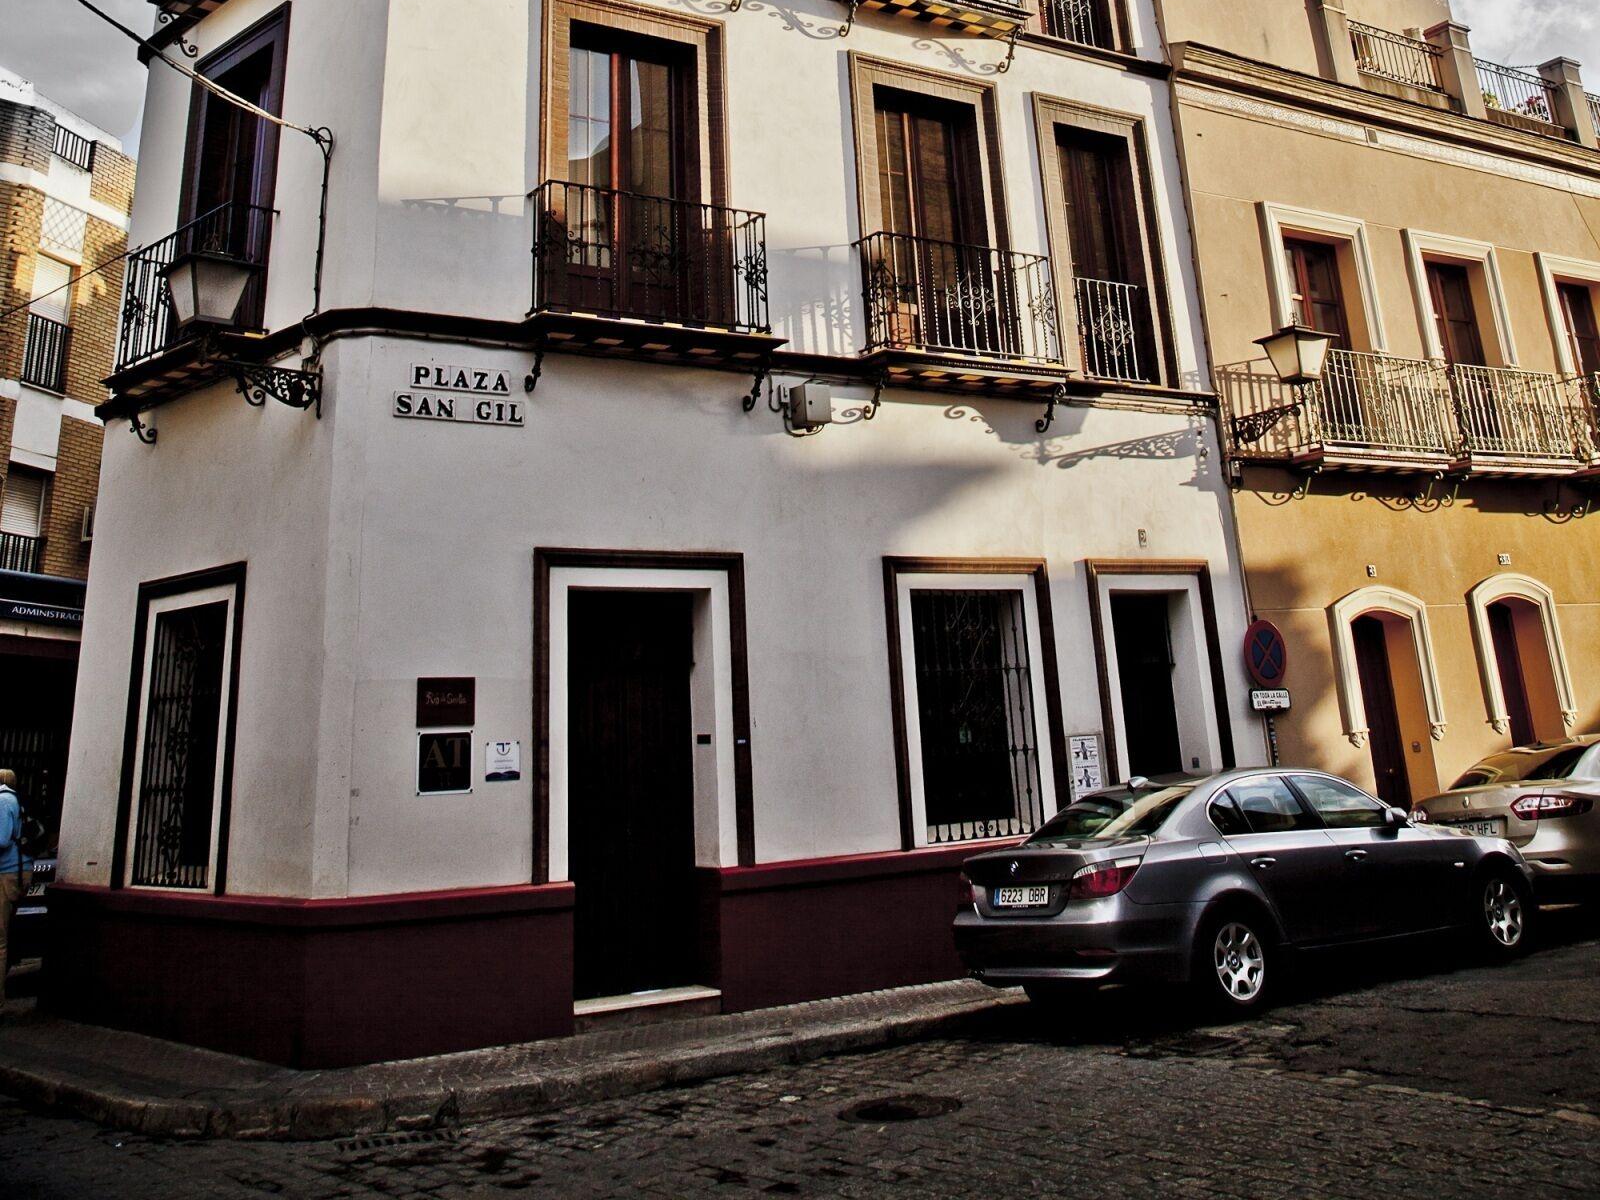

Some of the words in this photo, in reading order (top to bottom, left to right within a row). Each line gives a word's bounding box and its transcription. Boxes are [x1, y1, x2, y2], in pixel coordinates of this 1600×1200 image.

[413, 366, 509, 392] PLAZA
[396, 394, 454, 418] SAN
[475, 401, 523, 423] GIL
[11, 606, 83, 621] ADMINISTRACI
[1477, 821, 1497, 835] HFL
[1001, 889, 1023, 903] 6223
